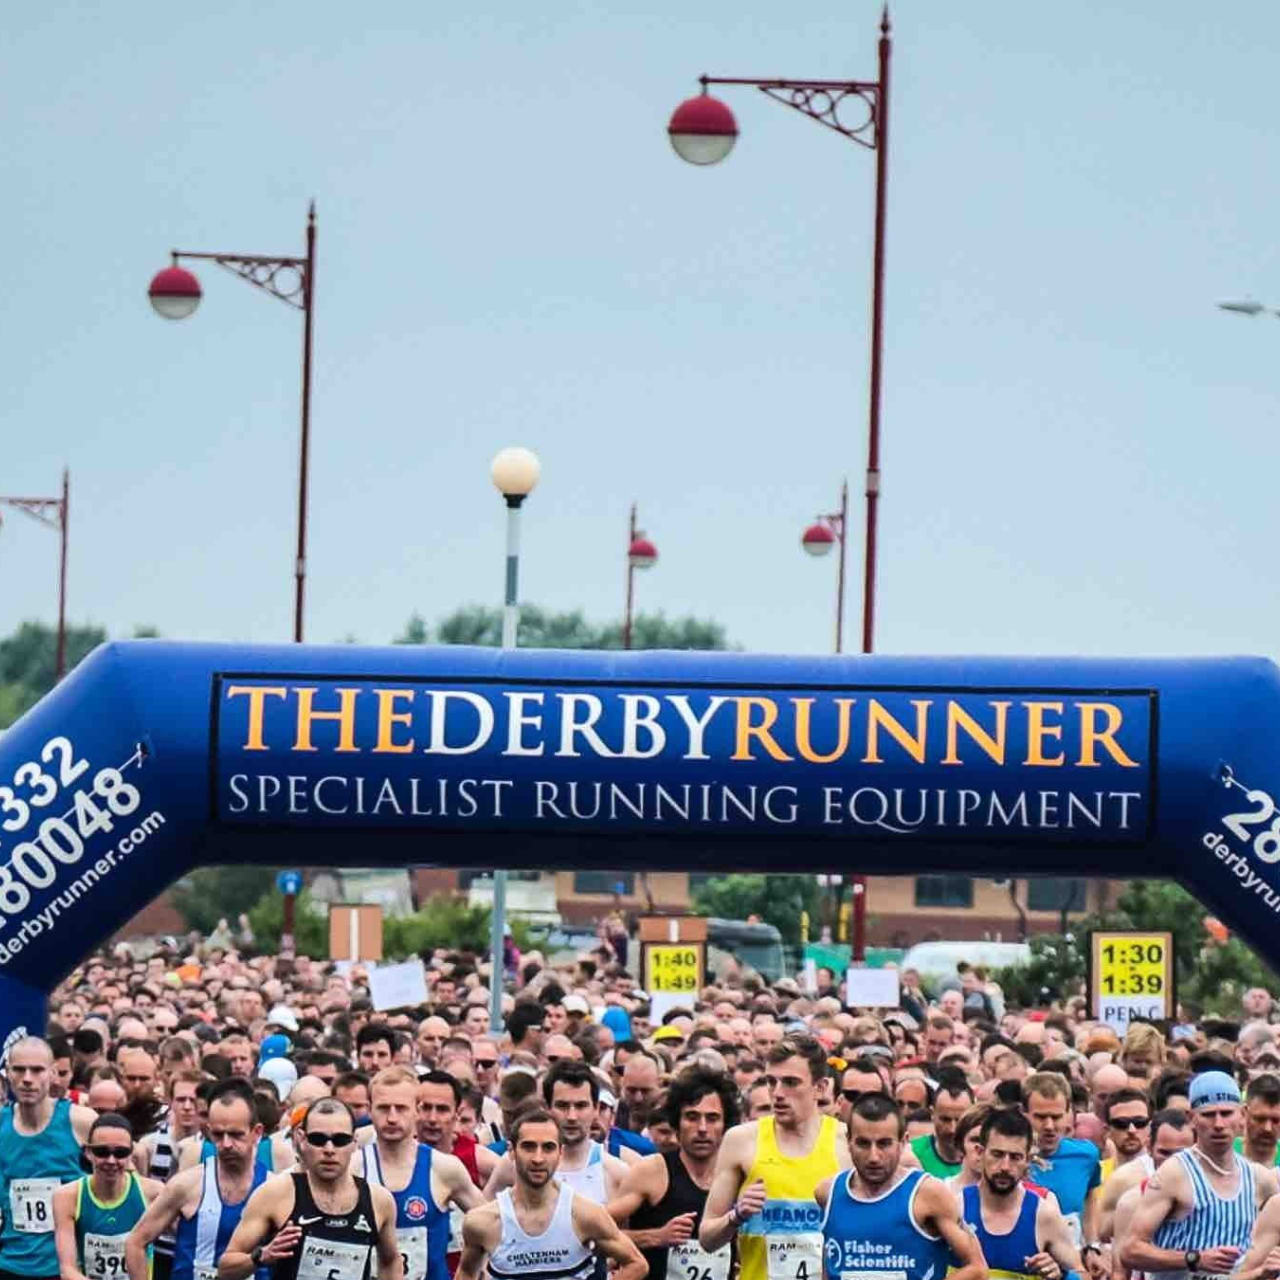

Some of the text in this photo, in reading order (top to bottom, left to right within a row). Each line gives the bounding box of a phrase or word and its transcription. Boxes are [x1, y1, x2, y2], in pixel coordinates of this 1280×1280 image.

[229, 774, 1142, 833] SPECIALIST RUNNING EQUIPMENT
[653, 952, 697, 967] 1:40
[1103, 944, 1163, 964] 1:30
[1103, 973, 1163, 994] 1:39
[1104, 1006, 1160, 1021] PEN C
[25, 1200, 48, 1222] 18
[843, 1240, 893, 1255] Fisher
[506, 1250, 569, 1263] CHELTENHAM
[843, 1254, 916, 1269] Scientific
